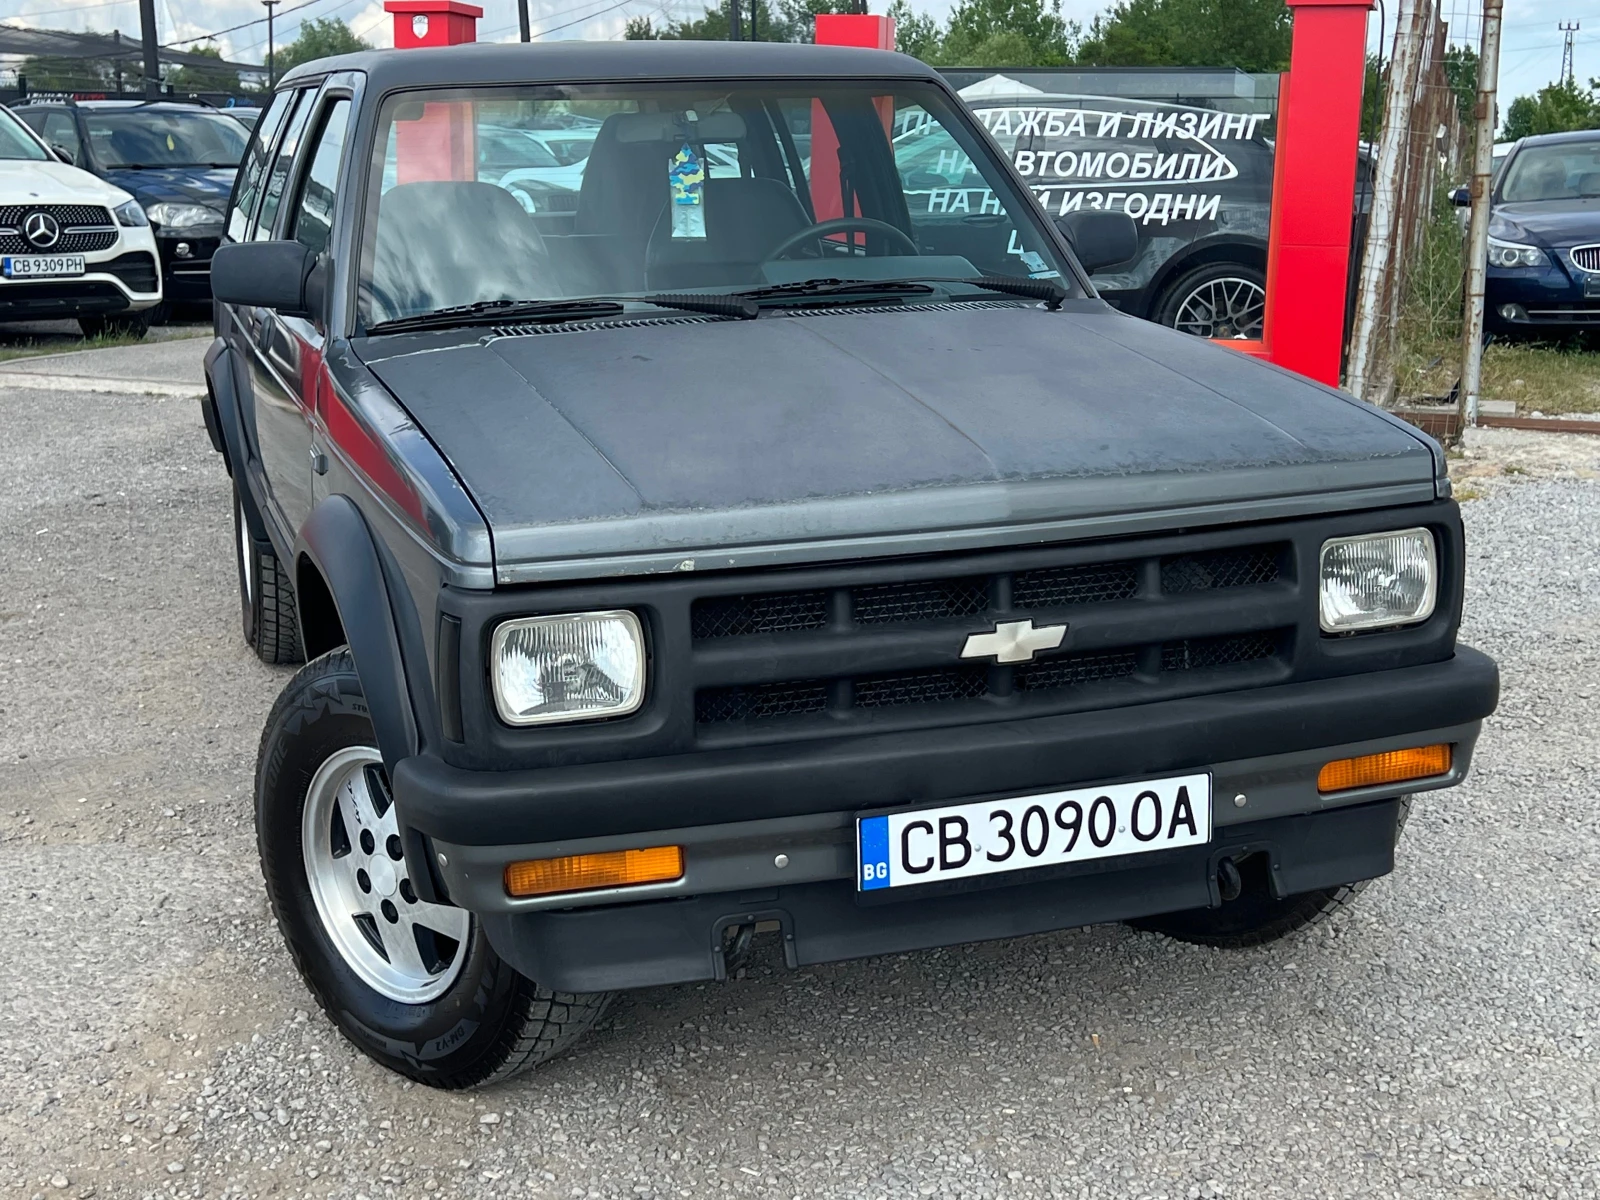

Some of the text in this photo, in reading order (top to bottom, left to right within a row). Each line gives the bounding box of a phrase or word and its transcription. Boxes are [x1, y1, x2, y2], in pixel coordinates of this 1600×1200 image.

[1096, 113, 1123, 138] И
[1127, 111, 1271, 141] ЛИЗИНГ
[936, 149, 1227, 180] НА ВТОМОБИЛИ
[928, 188, 970, 213] НА
[1058, 191, 1222, 226] ИЗГОДНИ
[33, 259, 64, 272] 9309
[901, 784, 1198, 875] CB 3090 OA
[863, 861, 888, 881] BG
[435, 1024, 465, 1050] DM-V2
